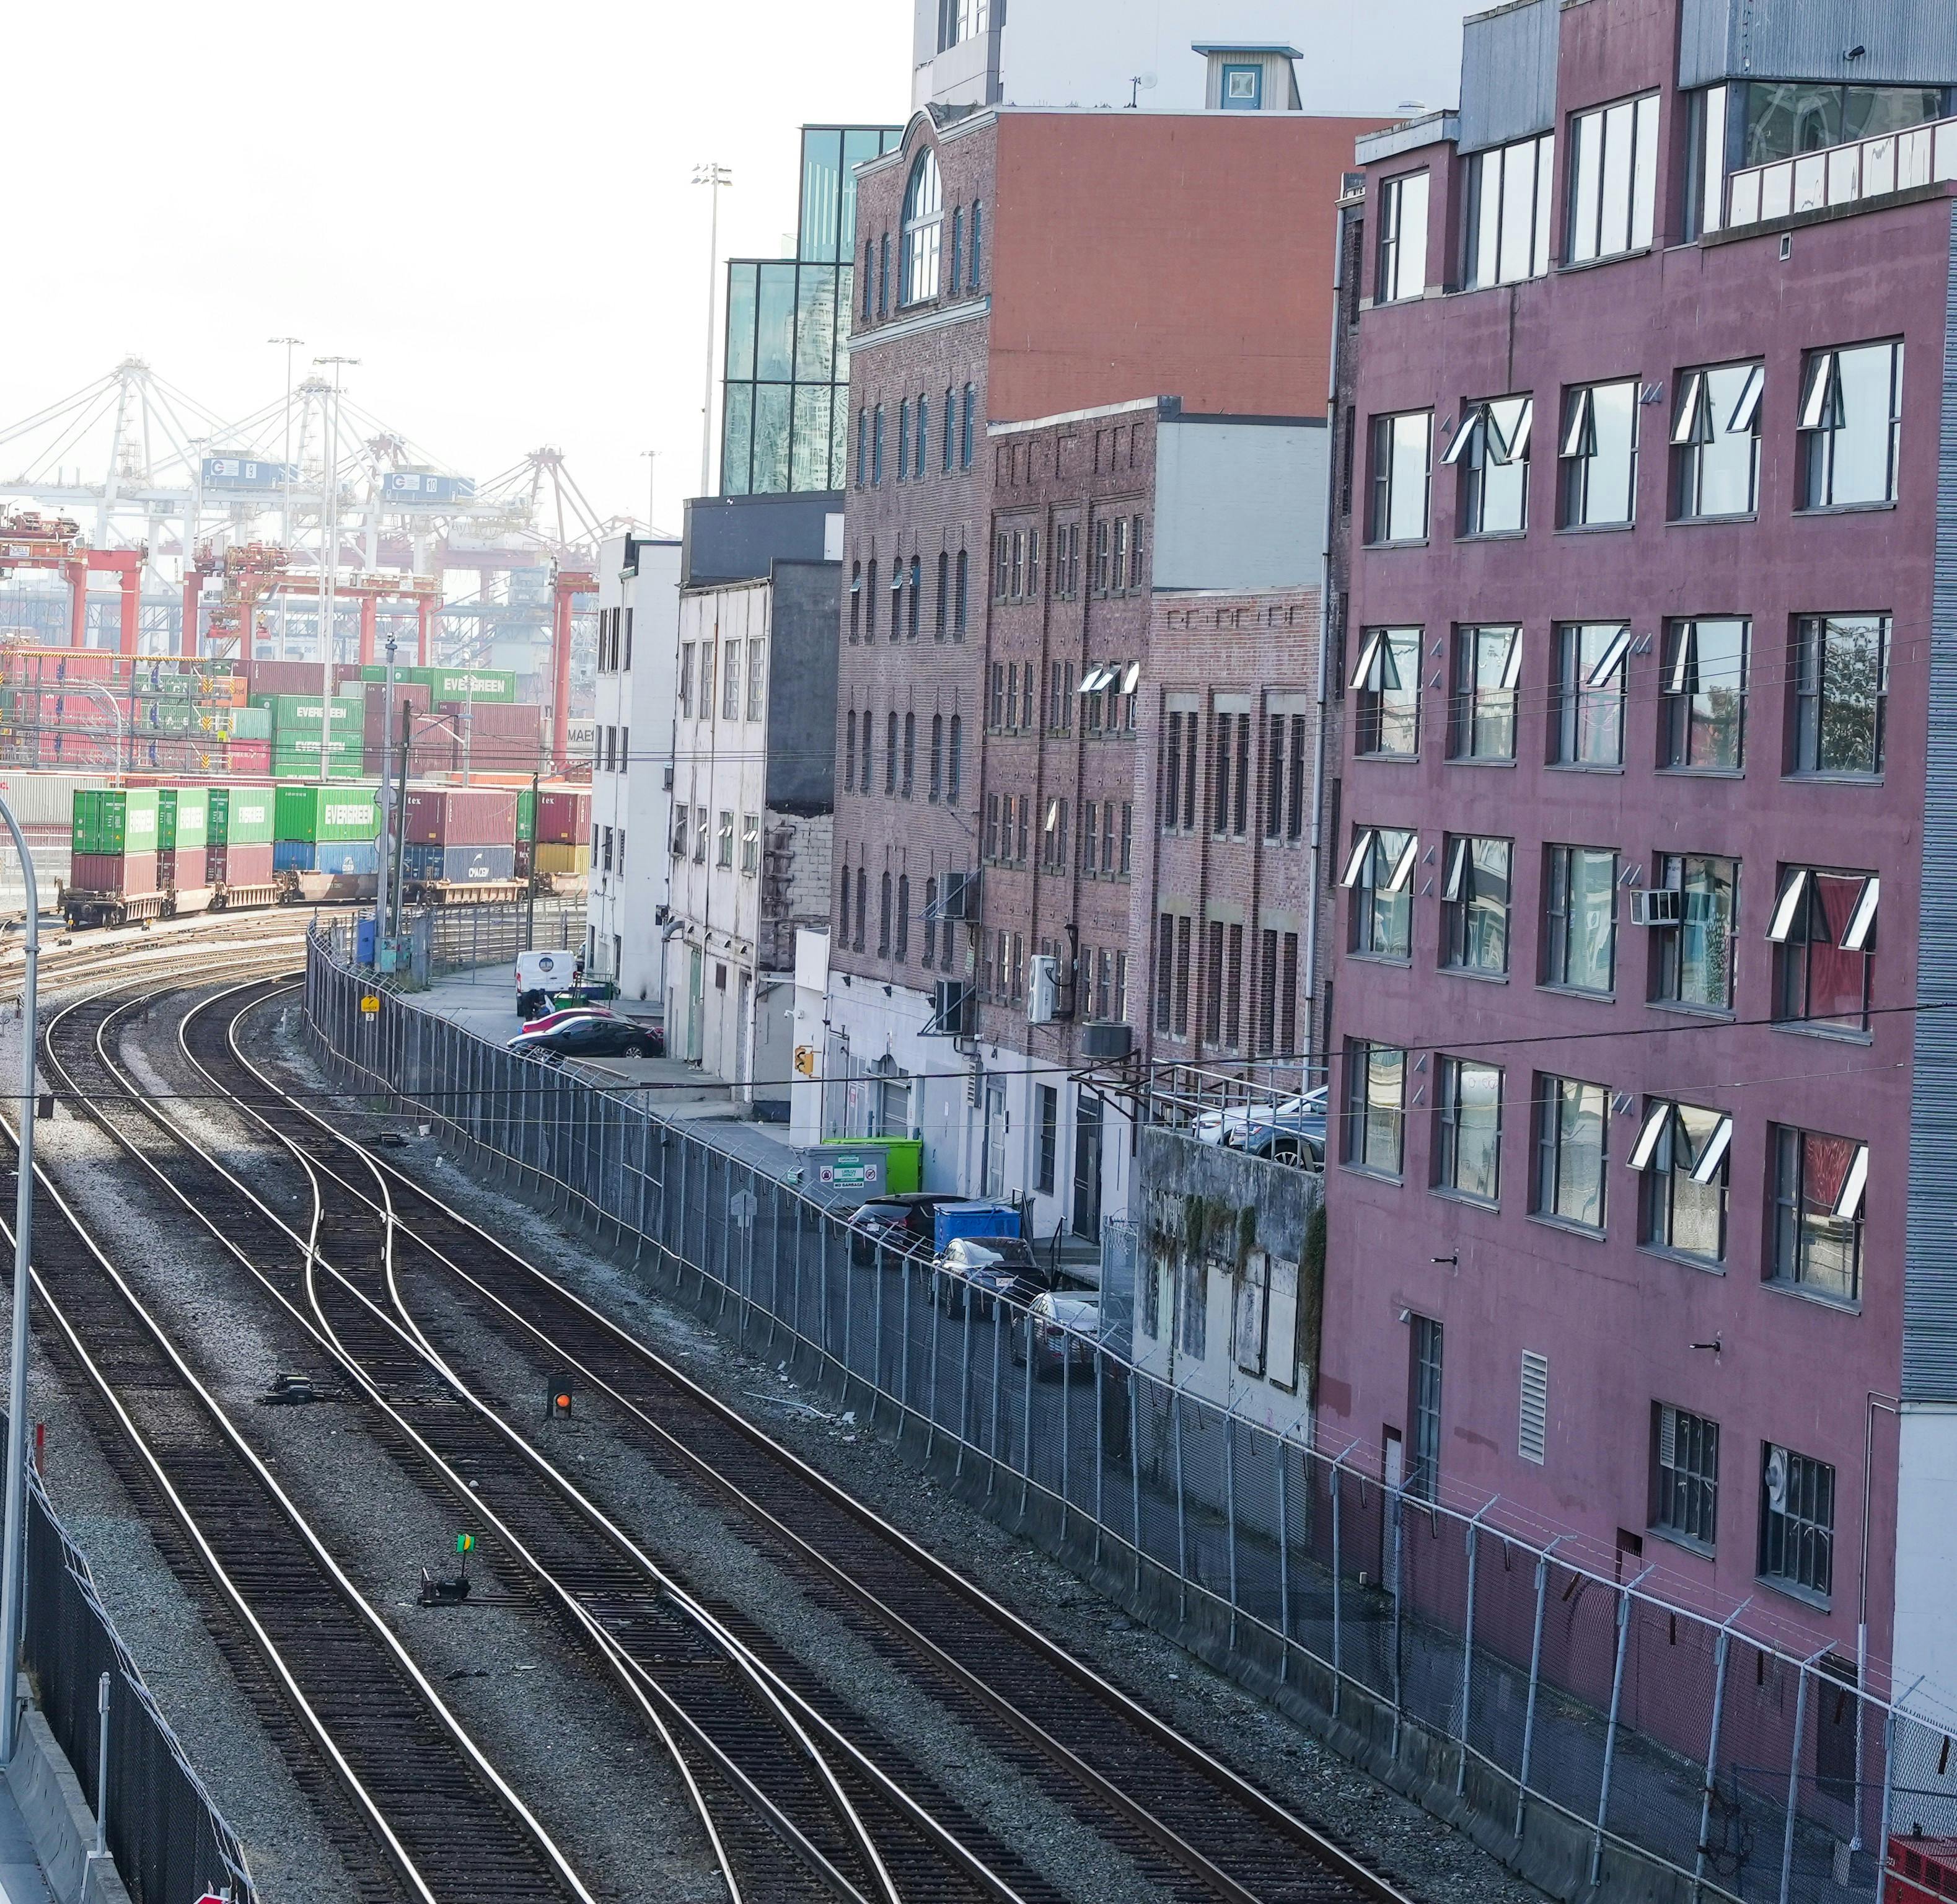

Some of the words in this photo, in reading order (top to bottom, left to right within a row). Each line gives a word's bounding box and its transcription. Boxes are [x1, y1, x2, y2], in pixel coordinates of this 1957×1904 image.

[428, 480, 436, 491] 10
[68, 545, 74, 554] 3
[445, 677, 505, 692] EVEGREEN
[297, 707, 347, 718] EVERGEEN
[295, 741, 345, 752] EVERGEEN
[408, 796, 421, 805] tex
[325, 804, 374, 825] EVERGREEN
